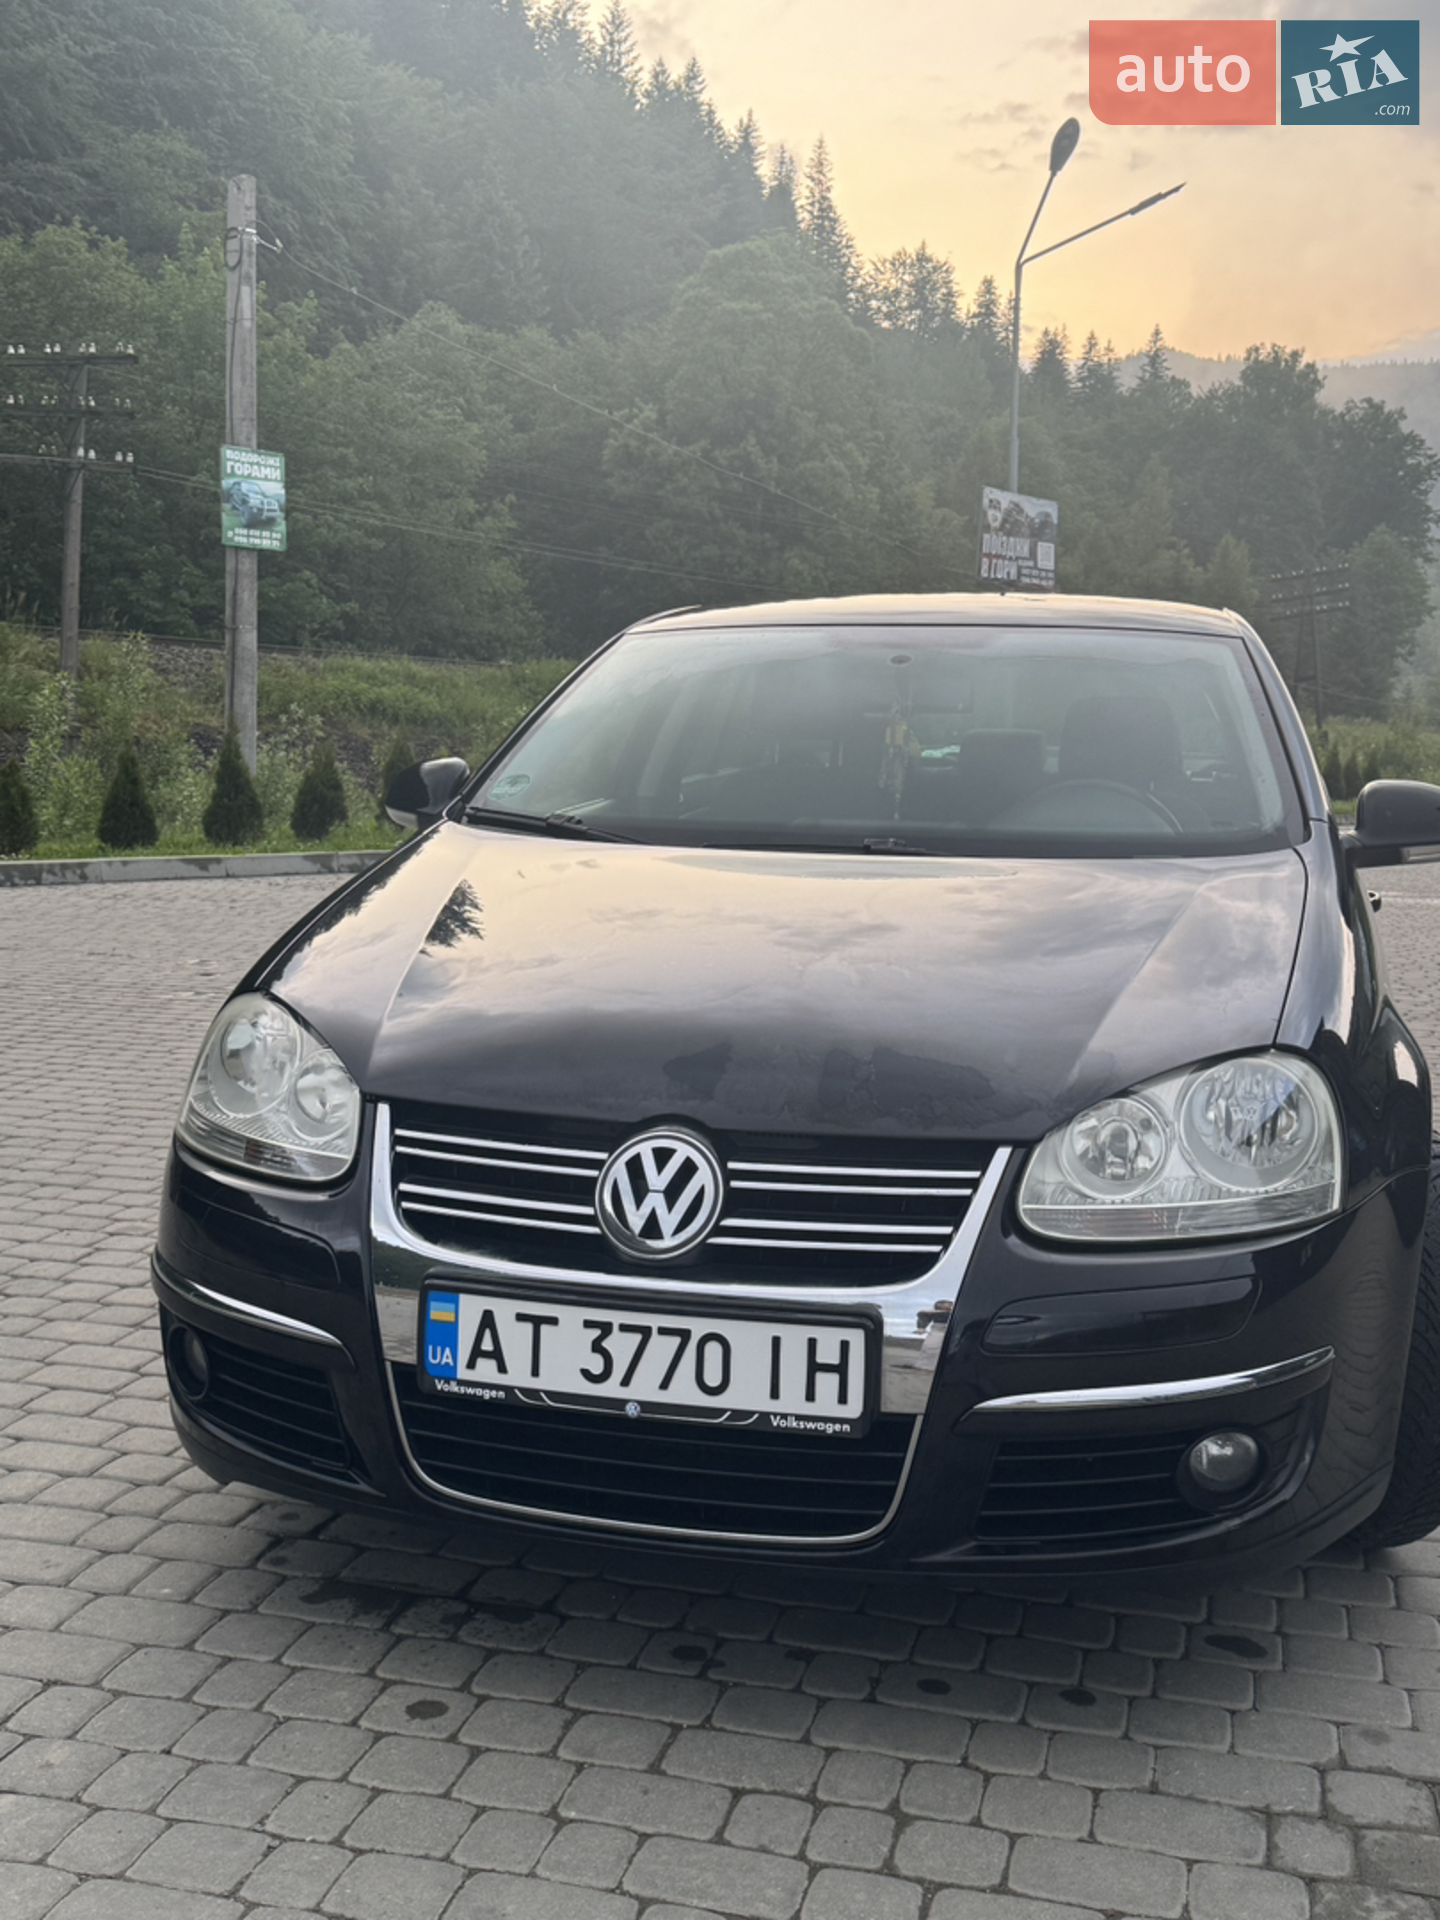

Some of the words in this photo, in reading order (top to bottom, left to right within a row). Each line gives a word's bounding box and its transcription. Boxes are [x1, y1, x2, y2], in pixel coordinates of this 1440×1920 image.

[226, 461, 281, 481] ГОРАМИ
[990, 558, 1018, 580] ГОРИ
[428, 1345, 455, 1367] UA
[465, 1308, 559, 1378] AT
[579, 1318, 732, 1397] 3770
[769, 1335, 851, 1405] IH
[434, 1378, 506, 1400] Volkswagen
[769, 1415, 851, 1434] Volkswagen
